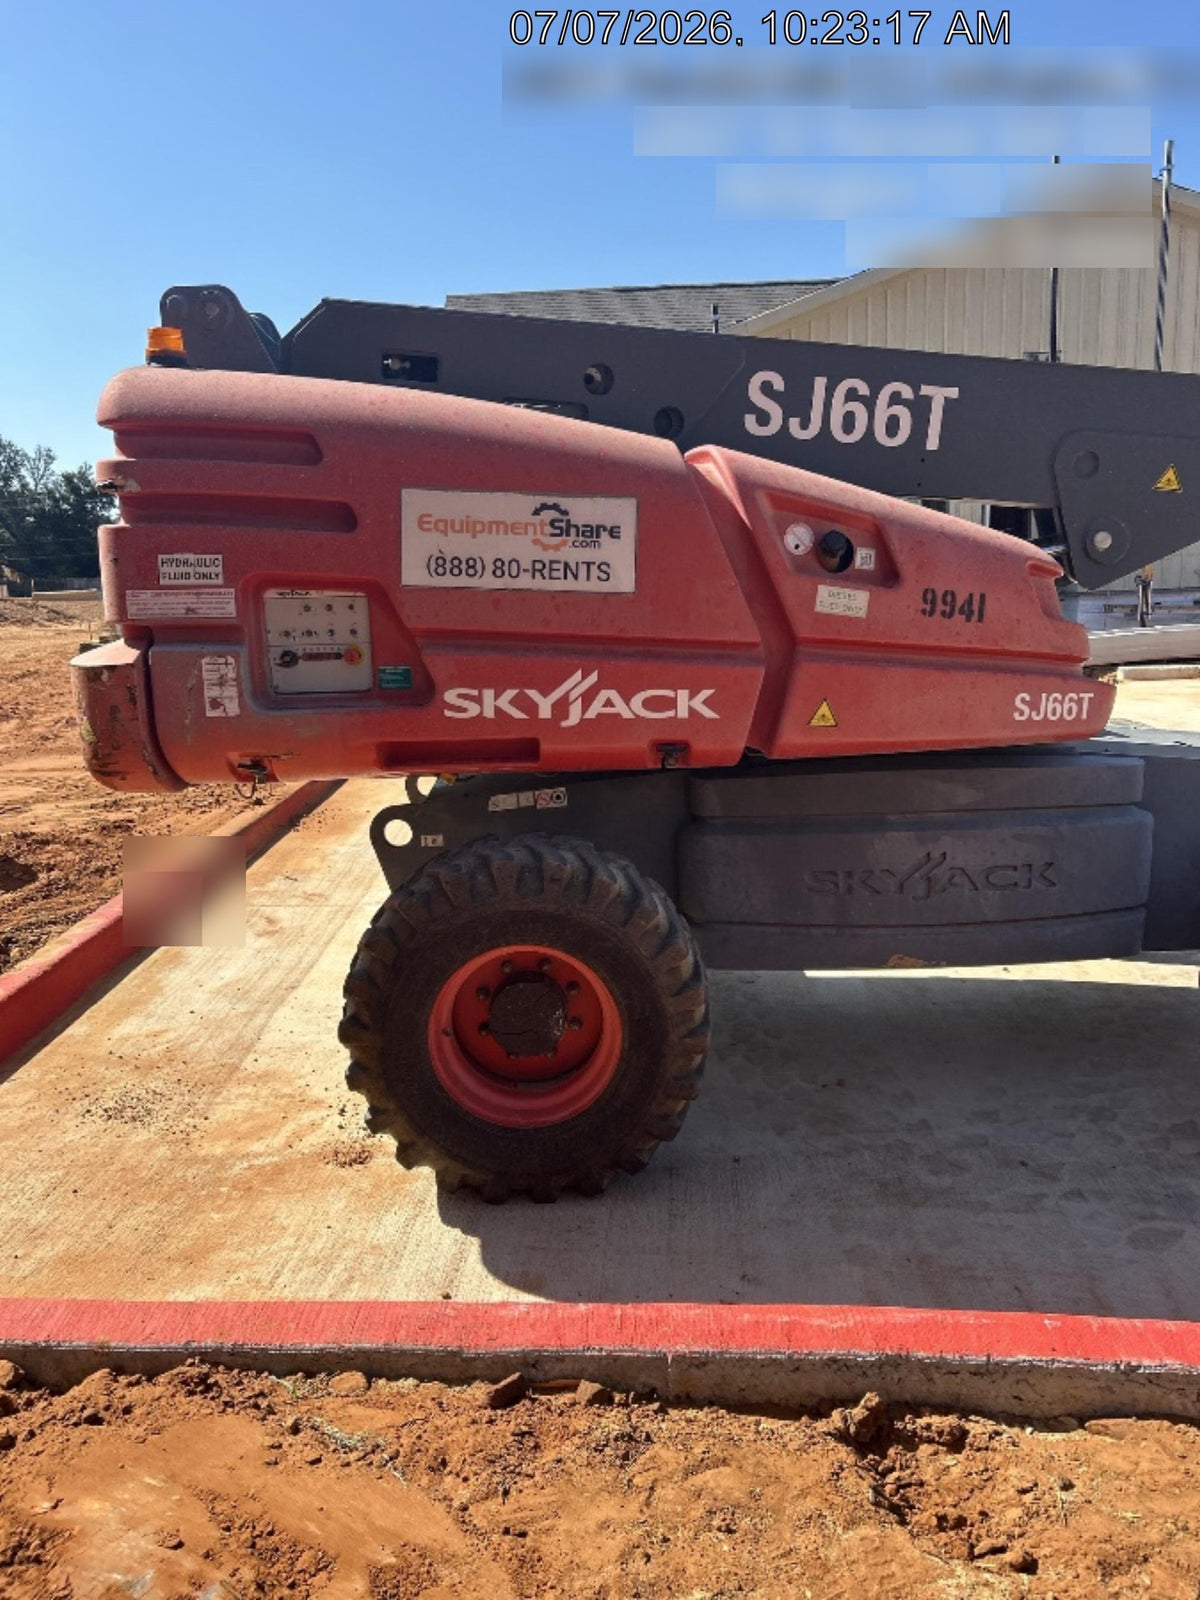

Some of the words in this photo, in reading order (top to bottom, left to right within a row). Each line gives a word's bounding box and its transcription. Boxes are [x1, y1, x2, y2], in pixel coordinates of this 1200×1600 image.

[744, 370, 960, 451] SJ66T
[417, 513, 621, 540] EquipmentShare
[569, 539, 601, 549] .com
[161, 572, 191, 580] FLUID
[193, 571, 221, 581] ONLY
[426, 553, 486, 579] (888)
[492, 557, 611, 582] 80-RENTS
[921, 587, 986, 624] 9941
[443, 668, 720, 728] SKYJACK
[1013, 692, 1095, 721] SJ66T
[805, 850, 1058, 901] SKYJACK
